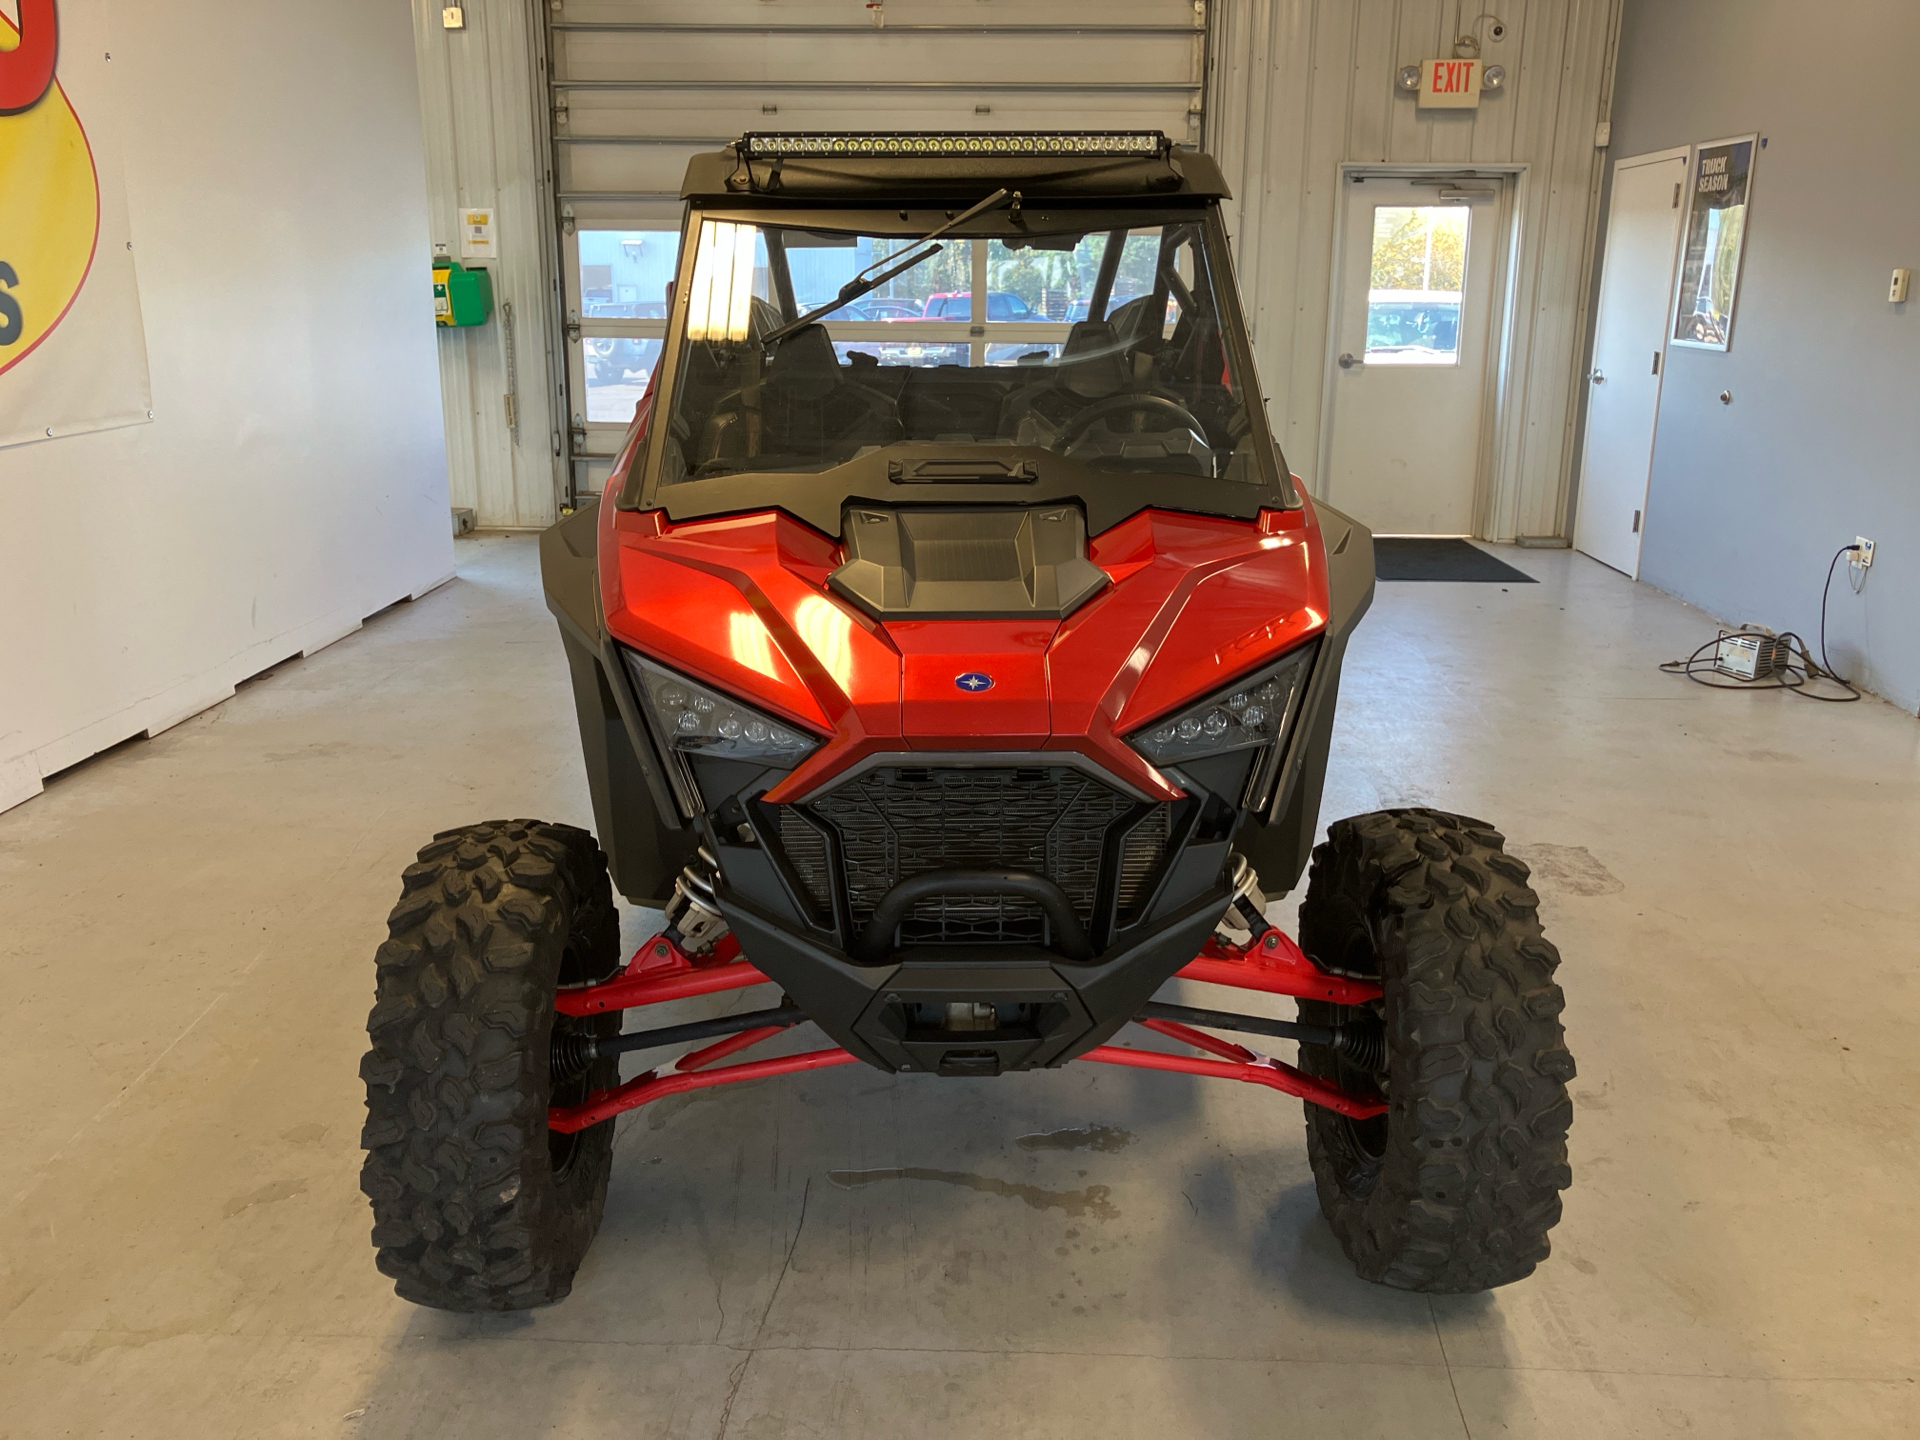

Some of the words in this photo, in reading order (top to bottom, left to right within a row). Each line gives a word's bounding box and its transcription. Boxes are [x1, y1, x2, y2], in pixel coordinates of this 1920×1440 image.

[1432, 62, 1474, 93] EXIT
[1702, 156, 1727, 175] TRUCK
[1699, 174, 1729, 192] SEASON
